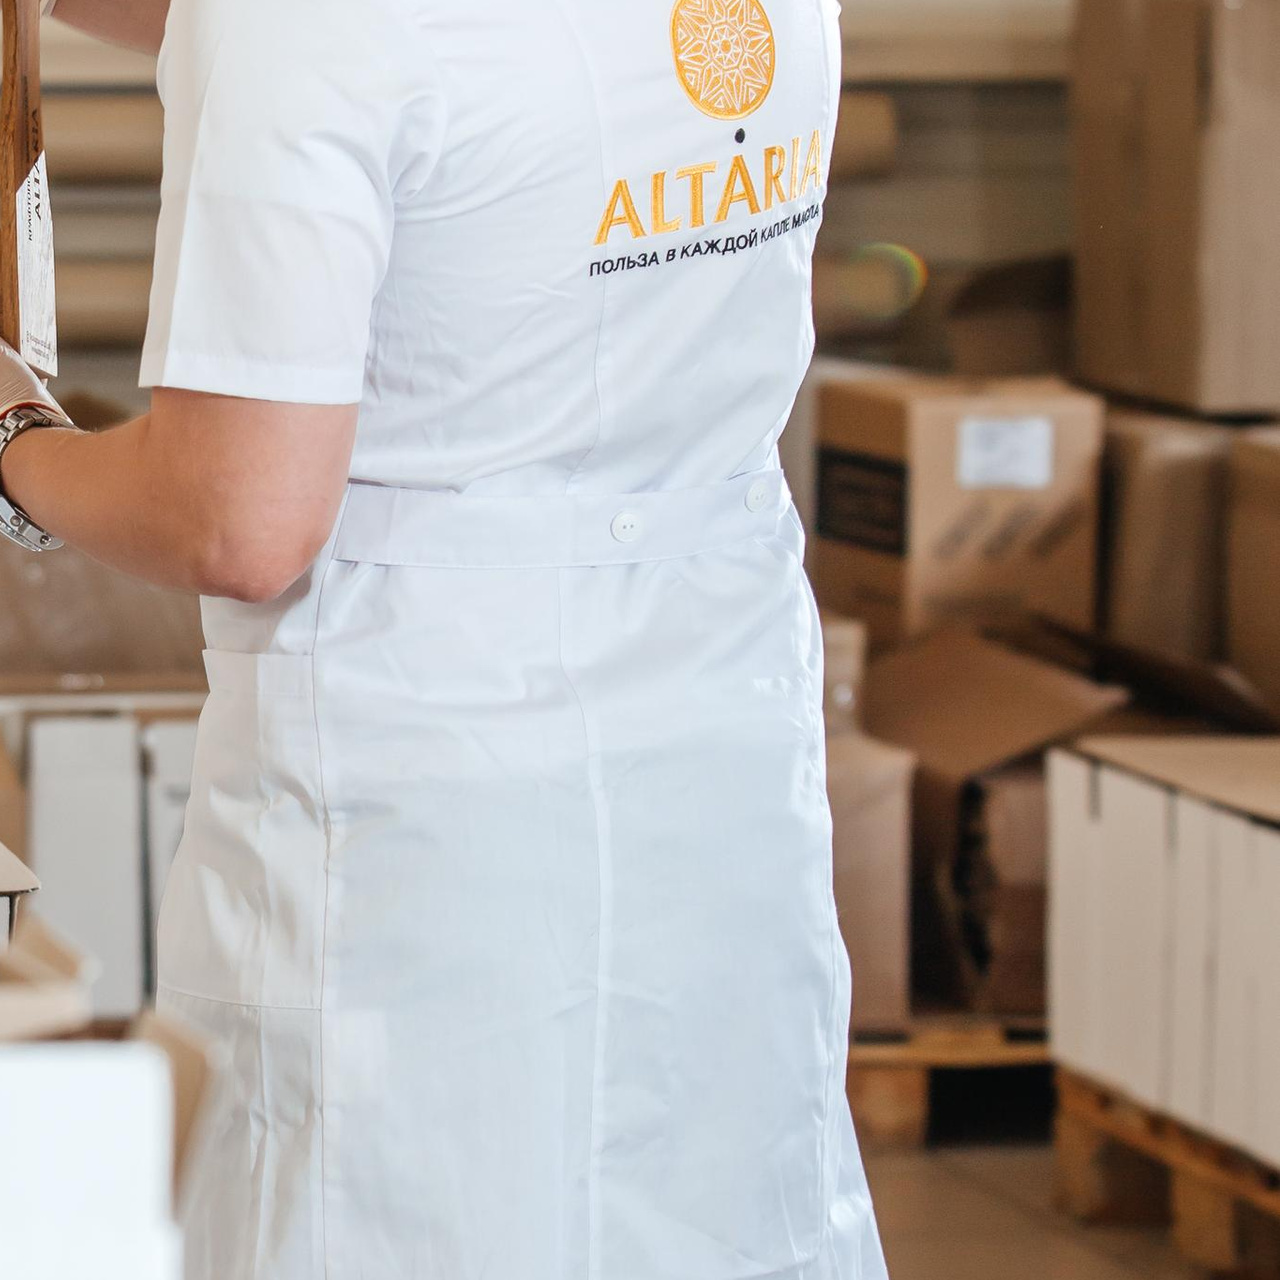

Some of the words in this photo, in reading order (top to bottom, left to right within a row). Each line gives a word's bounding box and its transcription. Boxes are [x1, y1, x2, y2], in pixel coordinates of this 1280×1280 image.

[592, 128, 821, 246] ALTARIA
[589, 250, 659, 277] ПОЛЬЗА
[665, 248, 676, 262] В
[680, 228, 758, 259] КАЖДОЙ
[760, 216, 790, 244] КАПЛЕ
